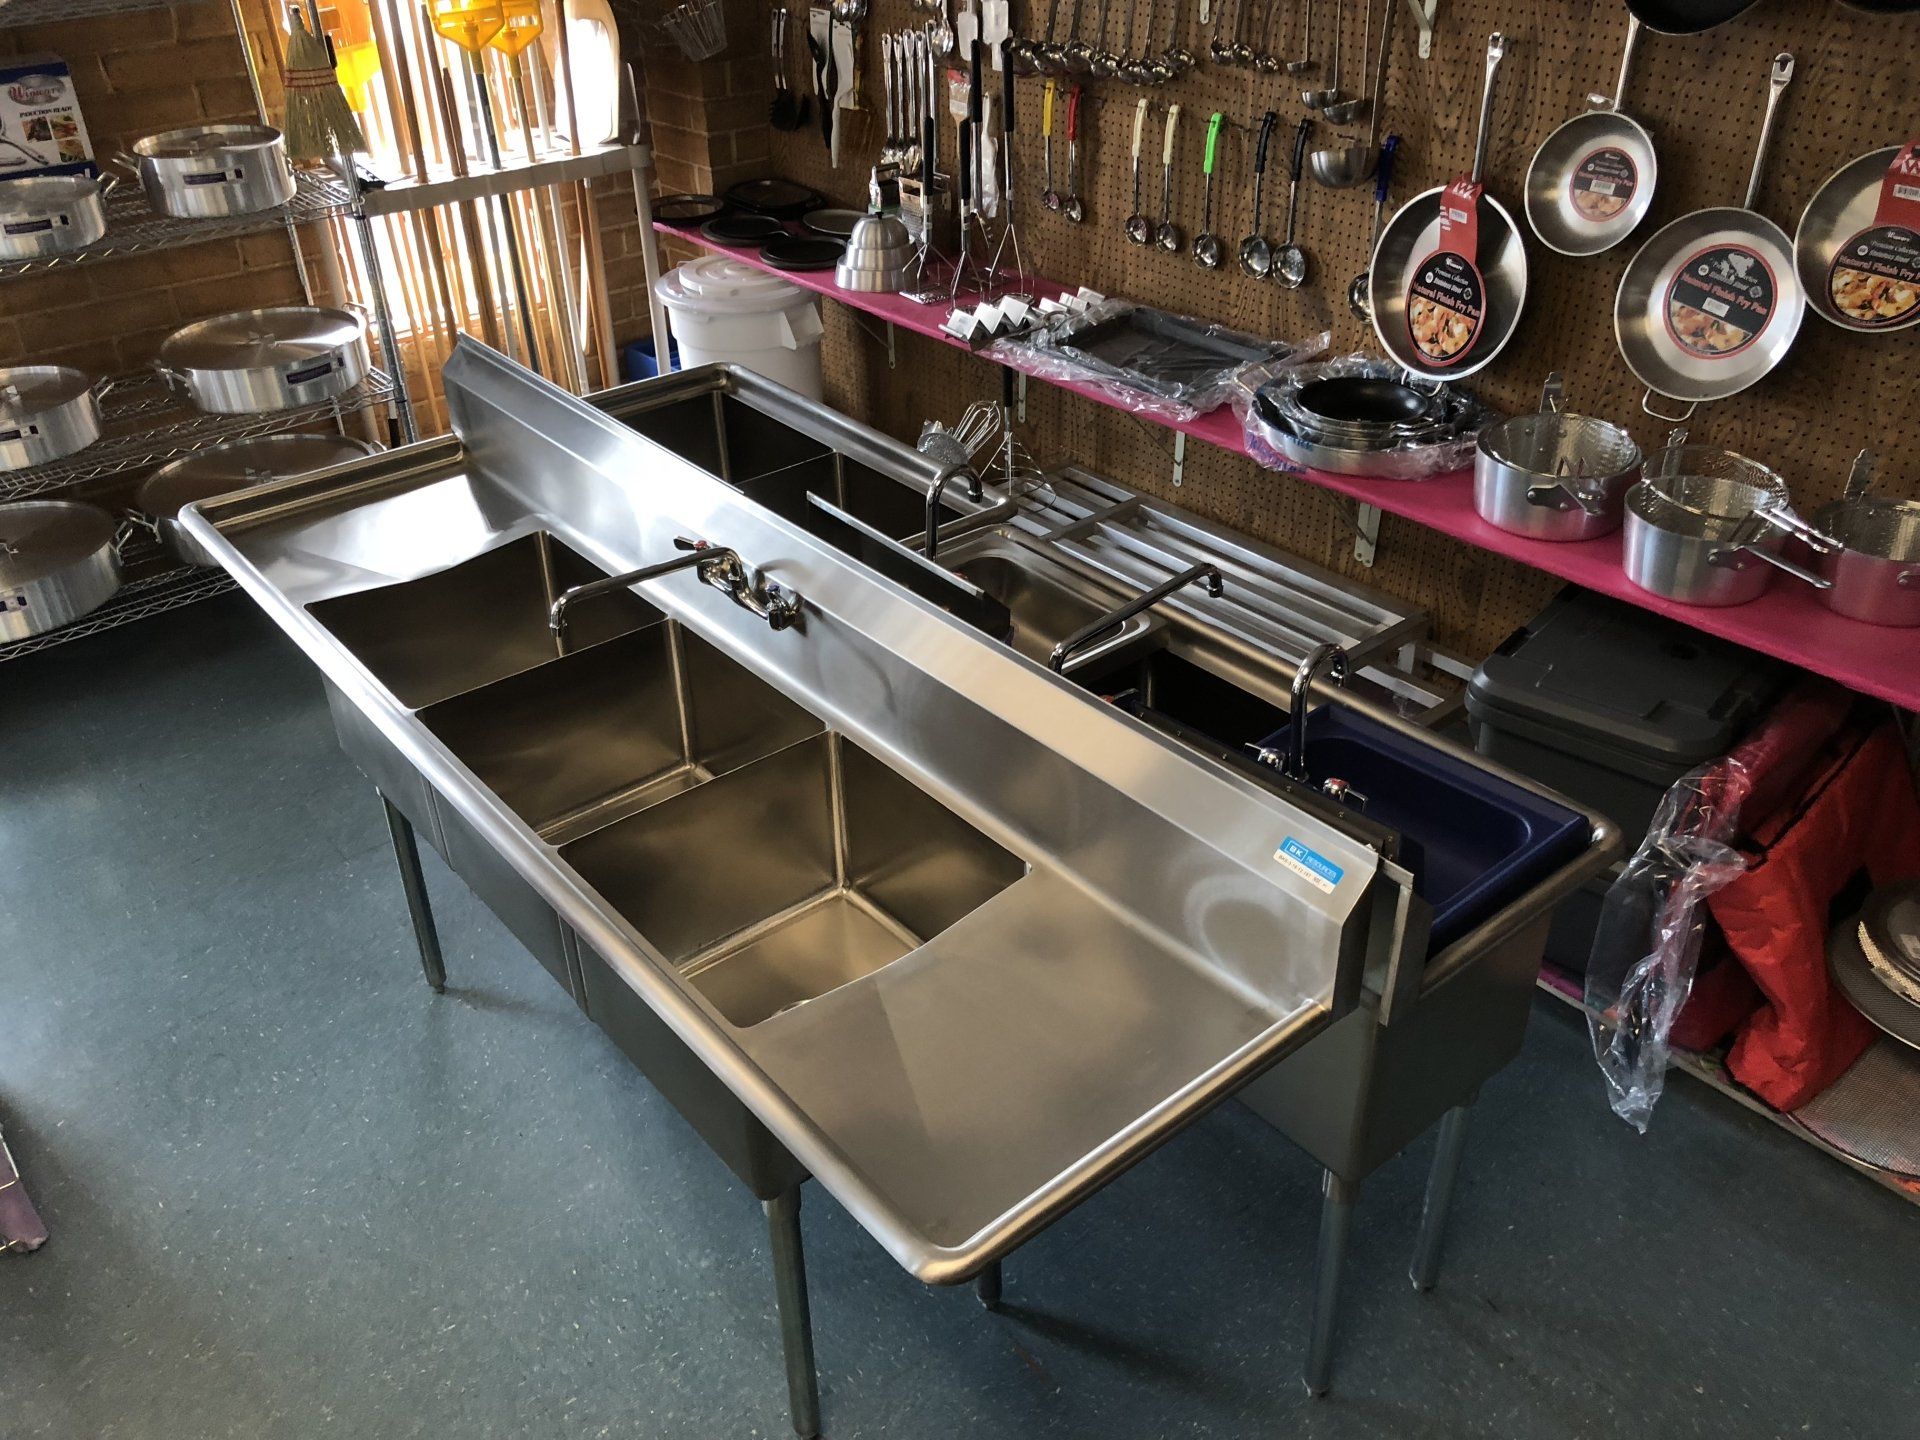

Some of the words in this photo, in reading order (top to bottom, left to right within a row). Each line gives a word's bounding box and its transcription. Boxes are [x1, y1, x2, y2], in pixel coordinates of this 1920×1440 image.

[1413, 282, 1436, 296] Natural
[1436, 291, 1454, 305] Finish
[1455, 299, 1467, 313] Fry
[1467, 305, 1481, 317] Pan
[1290, 845, 1303, 856] BK
